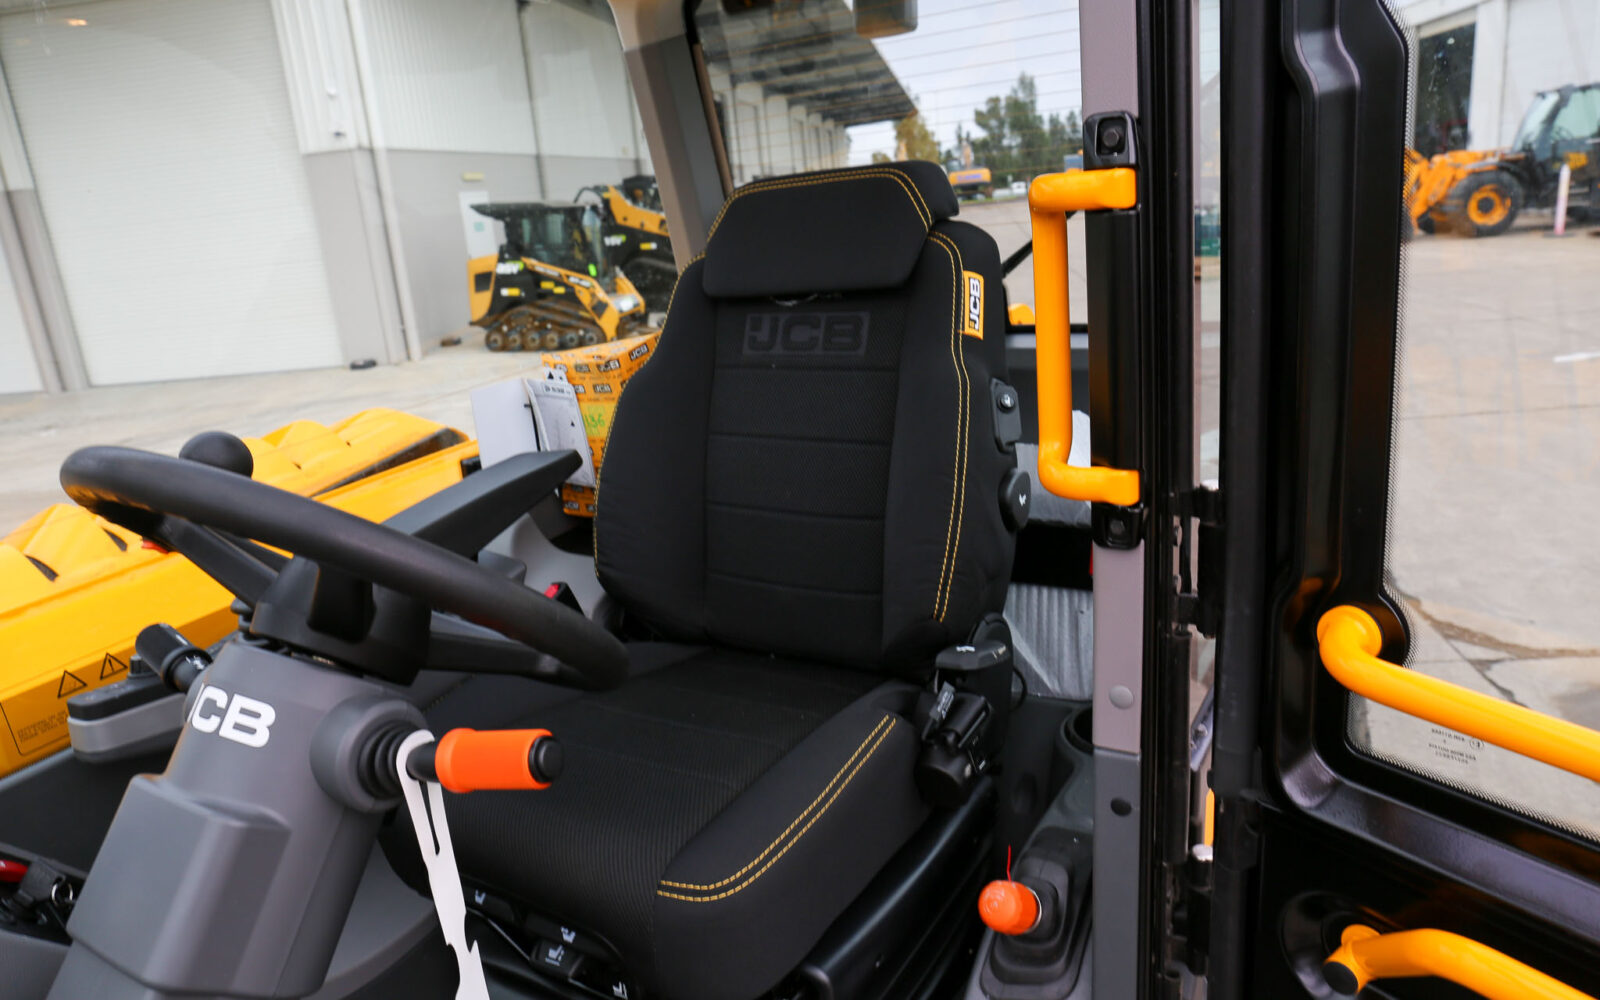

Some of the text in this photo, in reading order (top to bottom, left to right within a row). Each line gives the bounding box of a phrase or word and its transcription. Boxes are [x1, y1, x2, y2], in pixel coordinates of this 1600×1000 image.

[969, 277, 981, 331] JCB
[630, 343, 649, 361] JCB
[746, 312, 869, 354] JCB
[187, 683, 276, 748] CB
